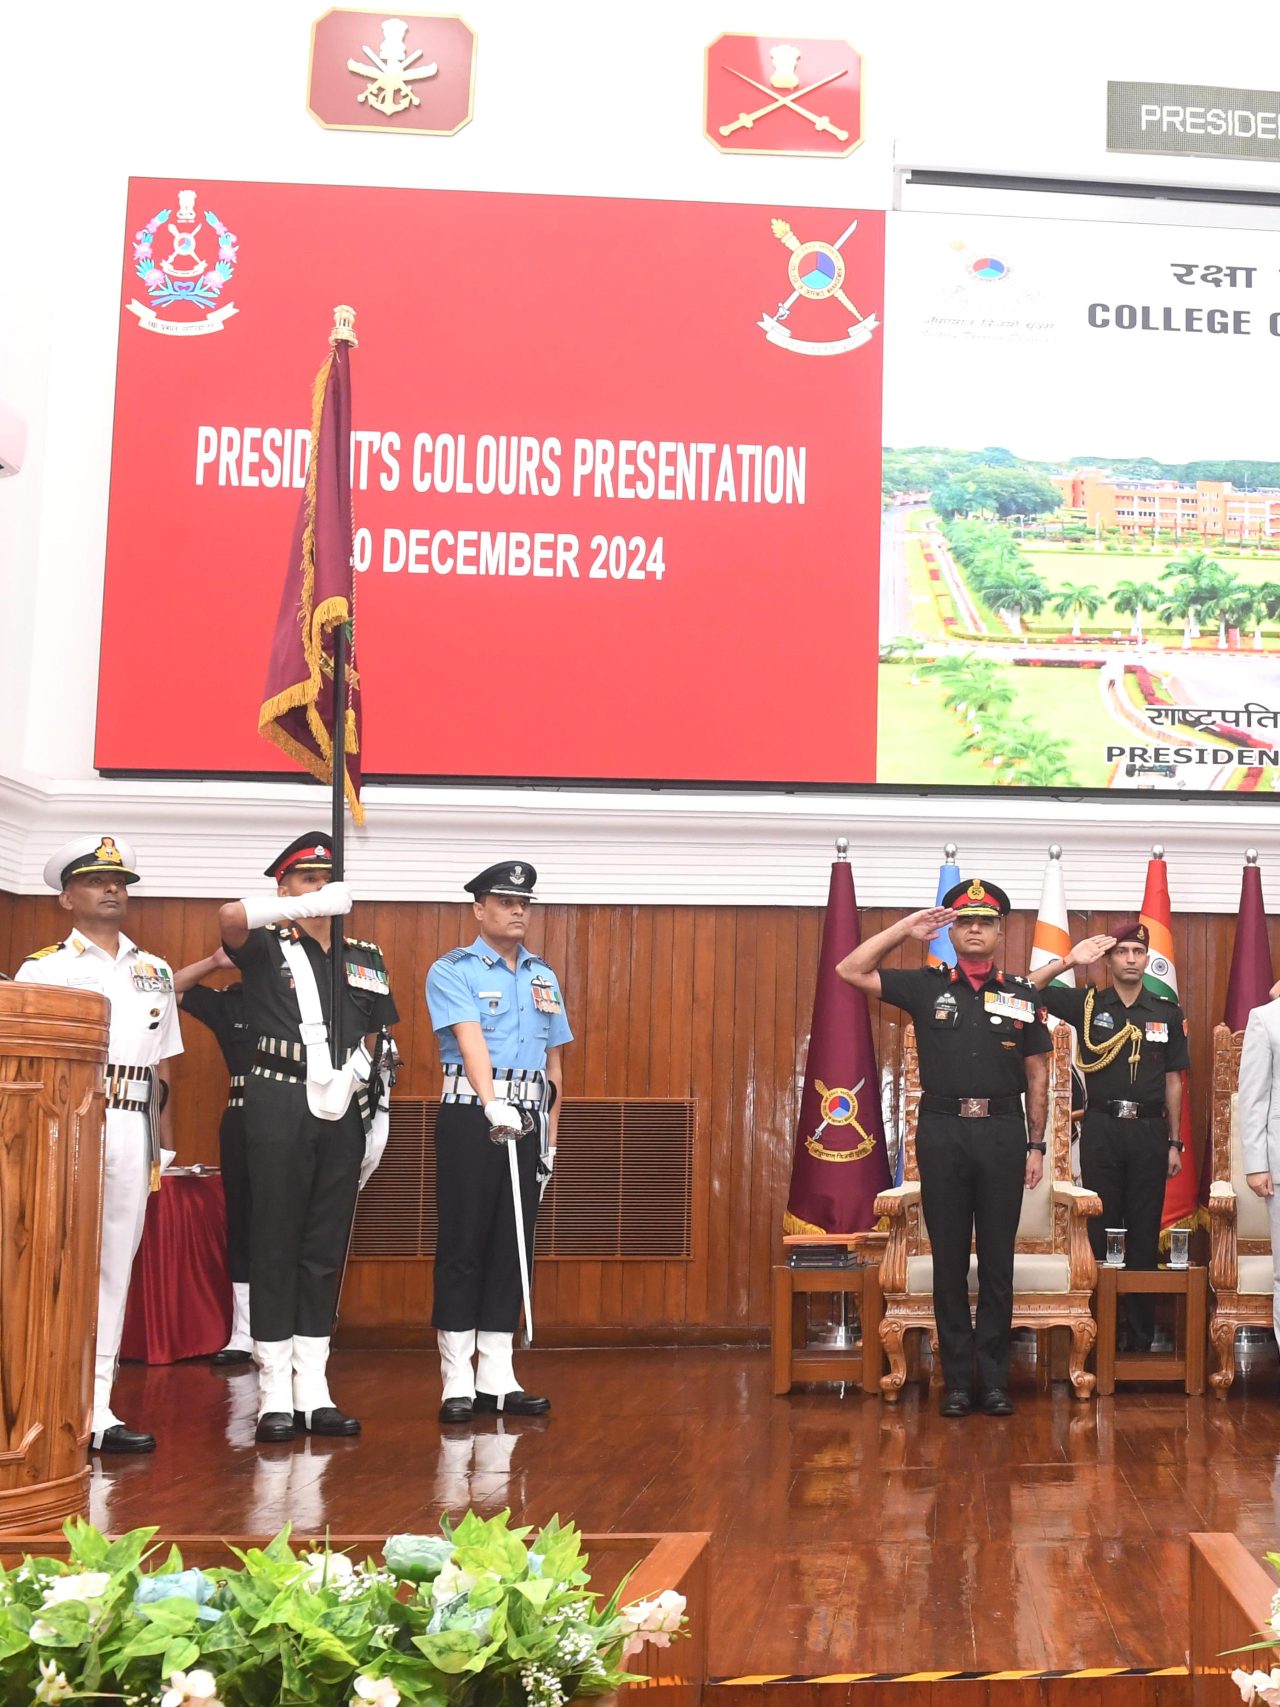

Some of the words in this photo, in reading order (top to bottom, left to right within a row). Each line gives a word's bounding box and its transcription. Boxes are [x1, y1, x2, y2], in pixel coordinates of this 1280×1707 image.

[1170, 263, 1257, 289] रक्षा
[1088, 303, 1251, 335] COLLEGE
[196, 426, 401, 492] PRESIDT'S
[413, 432, 562, 497] COLOURS
[574, 438, 806, 505] PRESENTATION
[350, 527, 372, 573] 0
[382, 528, 580, 578] DECEMBER
[588, 534, 666, 580] 2024
[1145, 703, 1280, 732] राष्ट्रपति
